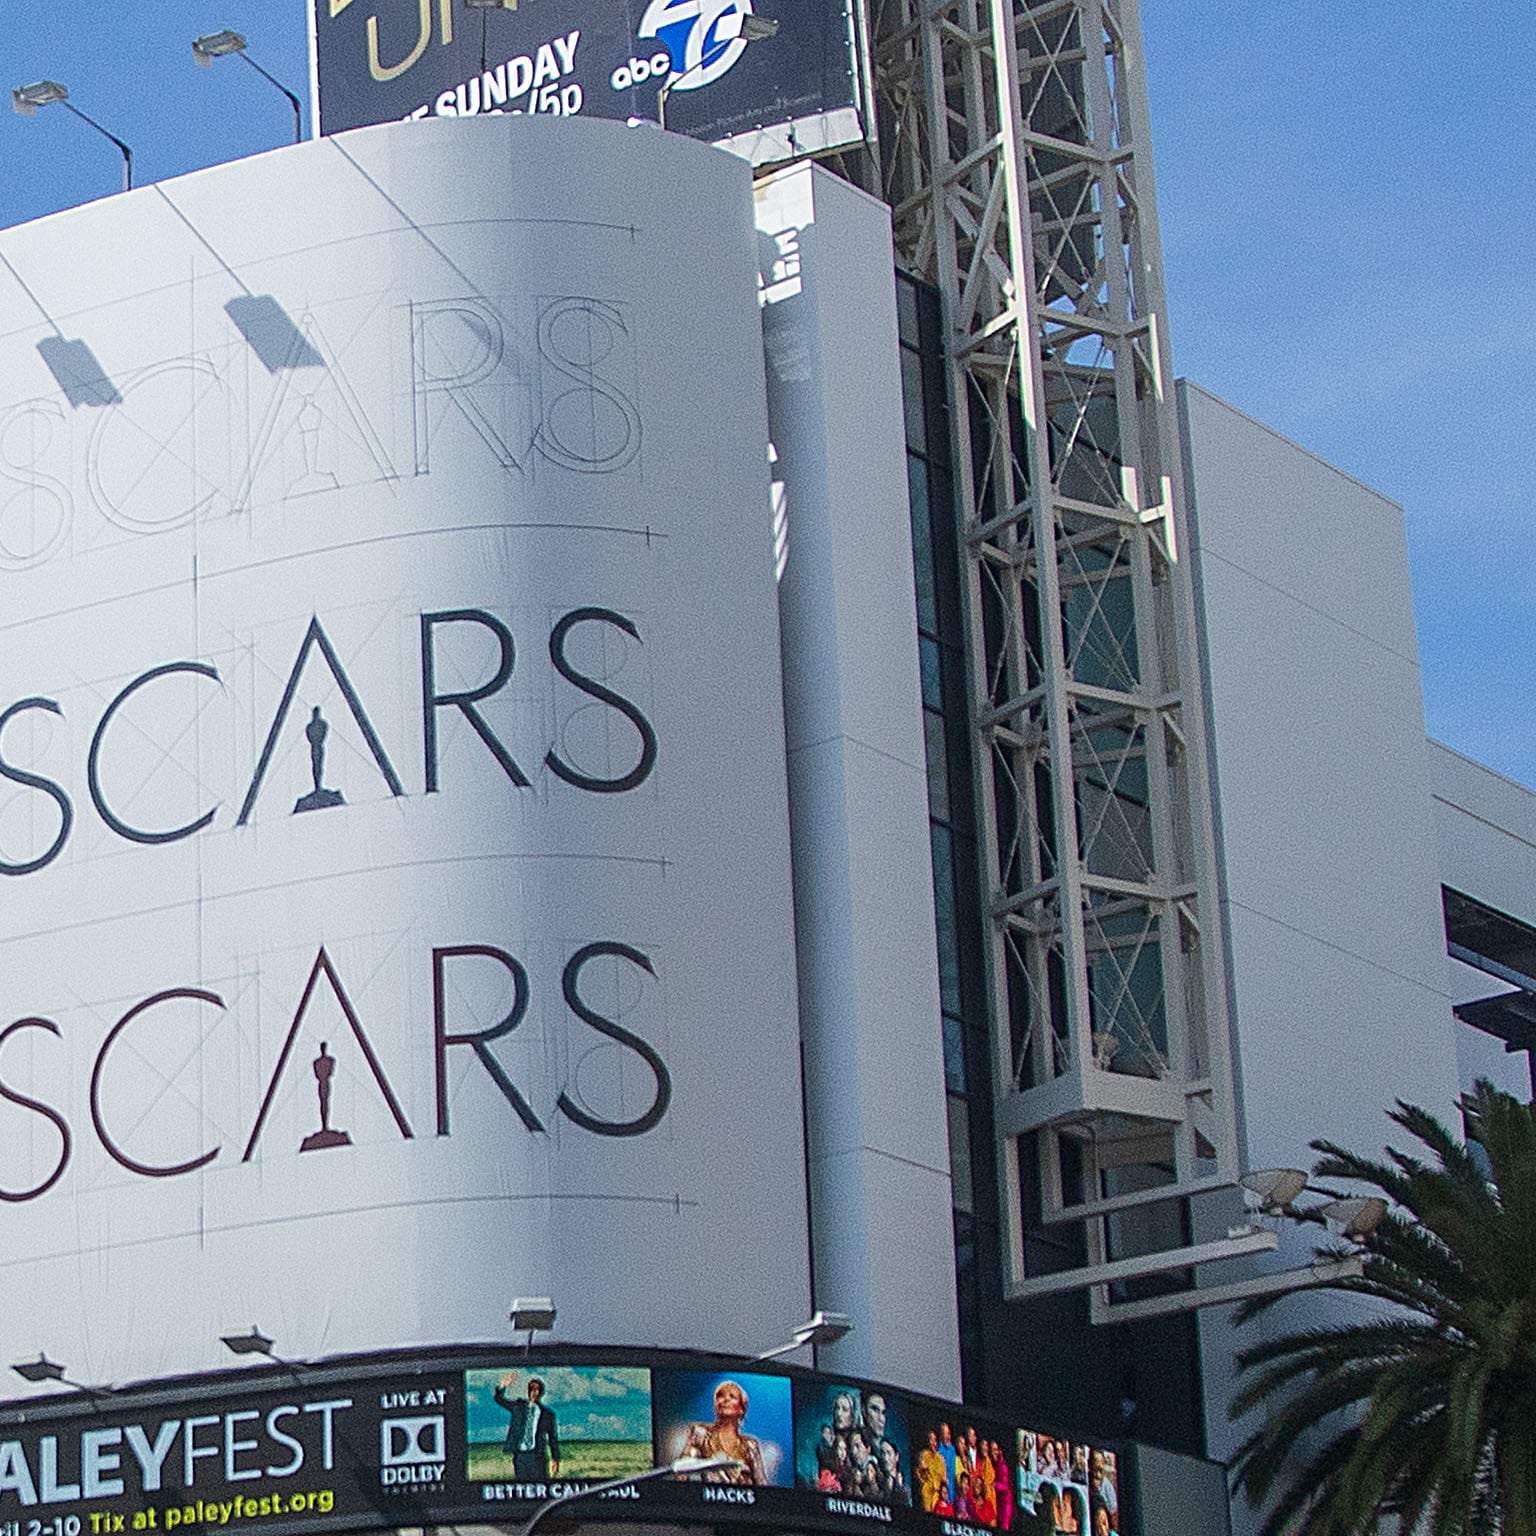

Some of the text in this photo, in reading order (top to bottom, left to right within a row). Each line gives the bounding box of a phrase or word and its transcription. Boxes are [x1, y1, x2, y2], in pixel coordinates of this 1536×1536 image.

[435, 29, 581, 117] SUNDAY
[611, 51, 670, 91] abc
[381, 1389, 447, 1410] LIVE AT
[382, 1464, 445, 1487] DOLBY
[482, 1483, 547, 1501] BETTER
[703, 1486, 756, 1504] HACKS
[89, 1511, 126, 1535] Tix
[132, 1507, 158, 1530] at
[164, 1488, 336, 1530] paleyfest.org
[827, 1498, 893, 1522] RIVERDALE
